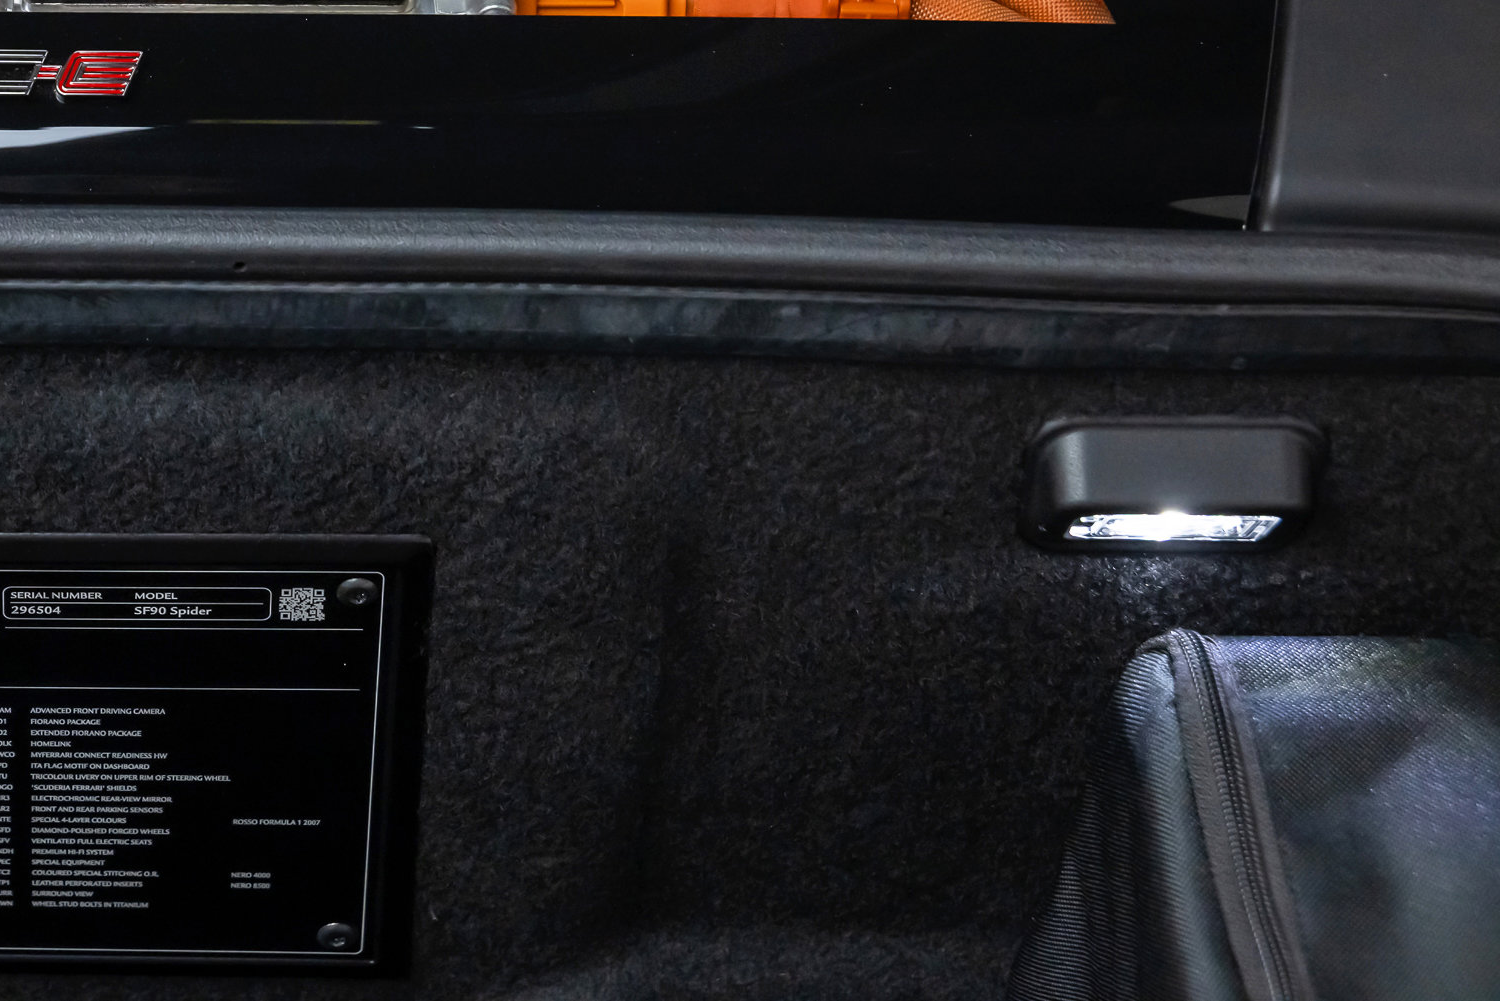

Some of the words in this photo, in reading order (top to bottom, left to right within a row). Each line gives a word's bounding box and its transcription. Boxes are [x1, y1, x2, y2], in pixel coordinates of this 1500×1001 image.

[10, 591, 50, 599] SERIAL
[51, 591, 103, 600] NUMBER
[134, 592, 178, 600] MODEL
[11, 605, 62, 615] 296504
[133, 606, 167, 615] SF90
[169, 606, 212, 617] Spider
[72, 707, 100, 715] FRONT
[99, 707, 132, 715] DRIVING
[132, 707, 166, 715] CAMERA
[66, 718, 101, 726] PACKAGE
[30, 729, 71, 737] EXTENDED
[71, 729, 107, 737] FIORANO
[73, 751, 112, 759] CONNECT
[43, 762, 63, 770] FLAG
[63, 762, 89, 770] MOTIF
[29, 773, 75, 781] TRICOLOUR
[74, 773, 100, 781] LIVERY
[166, 774, 204, 782] STEERING
[106, 784, 138, 792] SHIELDS
[100, 795, 142, 803] REAR-VIEW
[31, 805, 58, 813] FRONT
[57, 805, 75, 813] AND
[96, 806, 129, 814] PARKING
[129, 806, 164, 814] SENSORS
[60, 816, 91, 824] 4-LAYER
[232, 818, 259, 826] ROSSO
[258, 818, 297, 826] FORMULA
